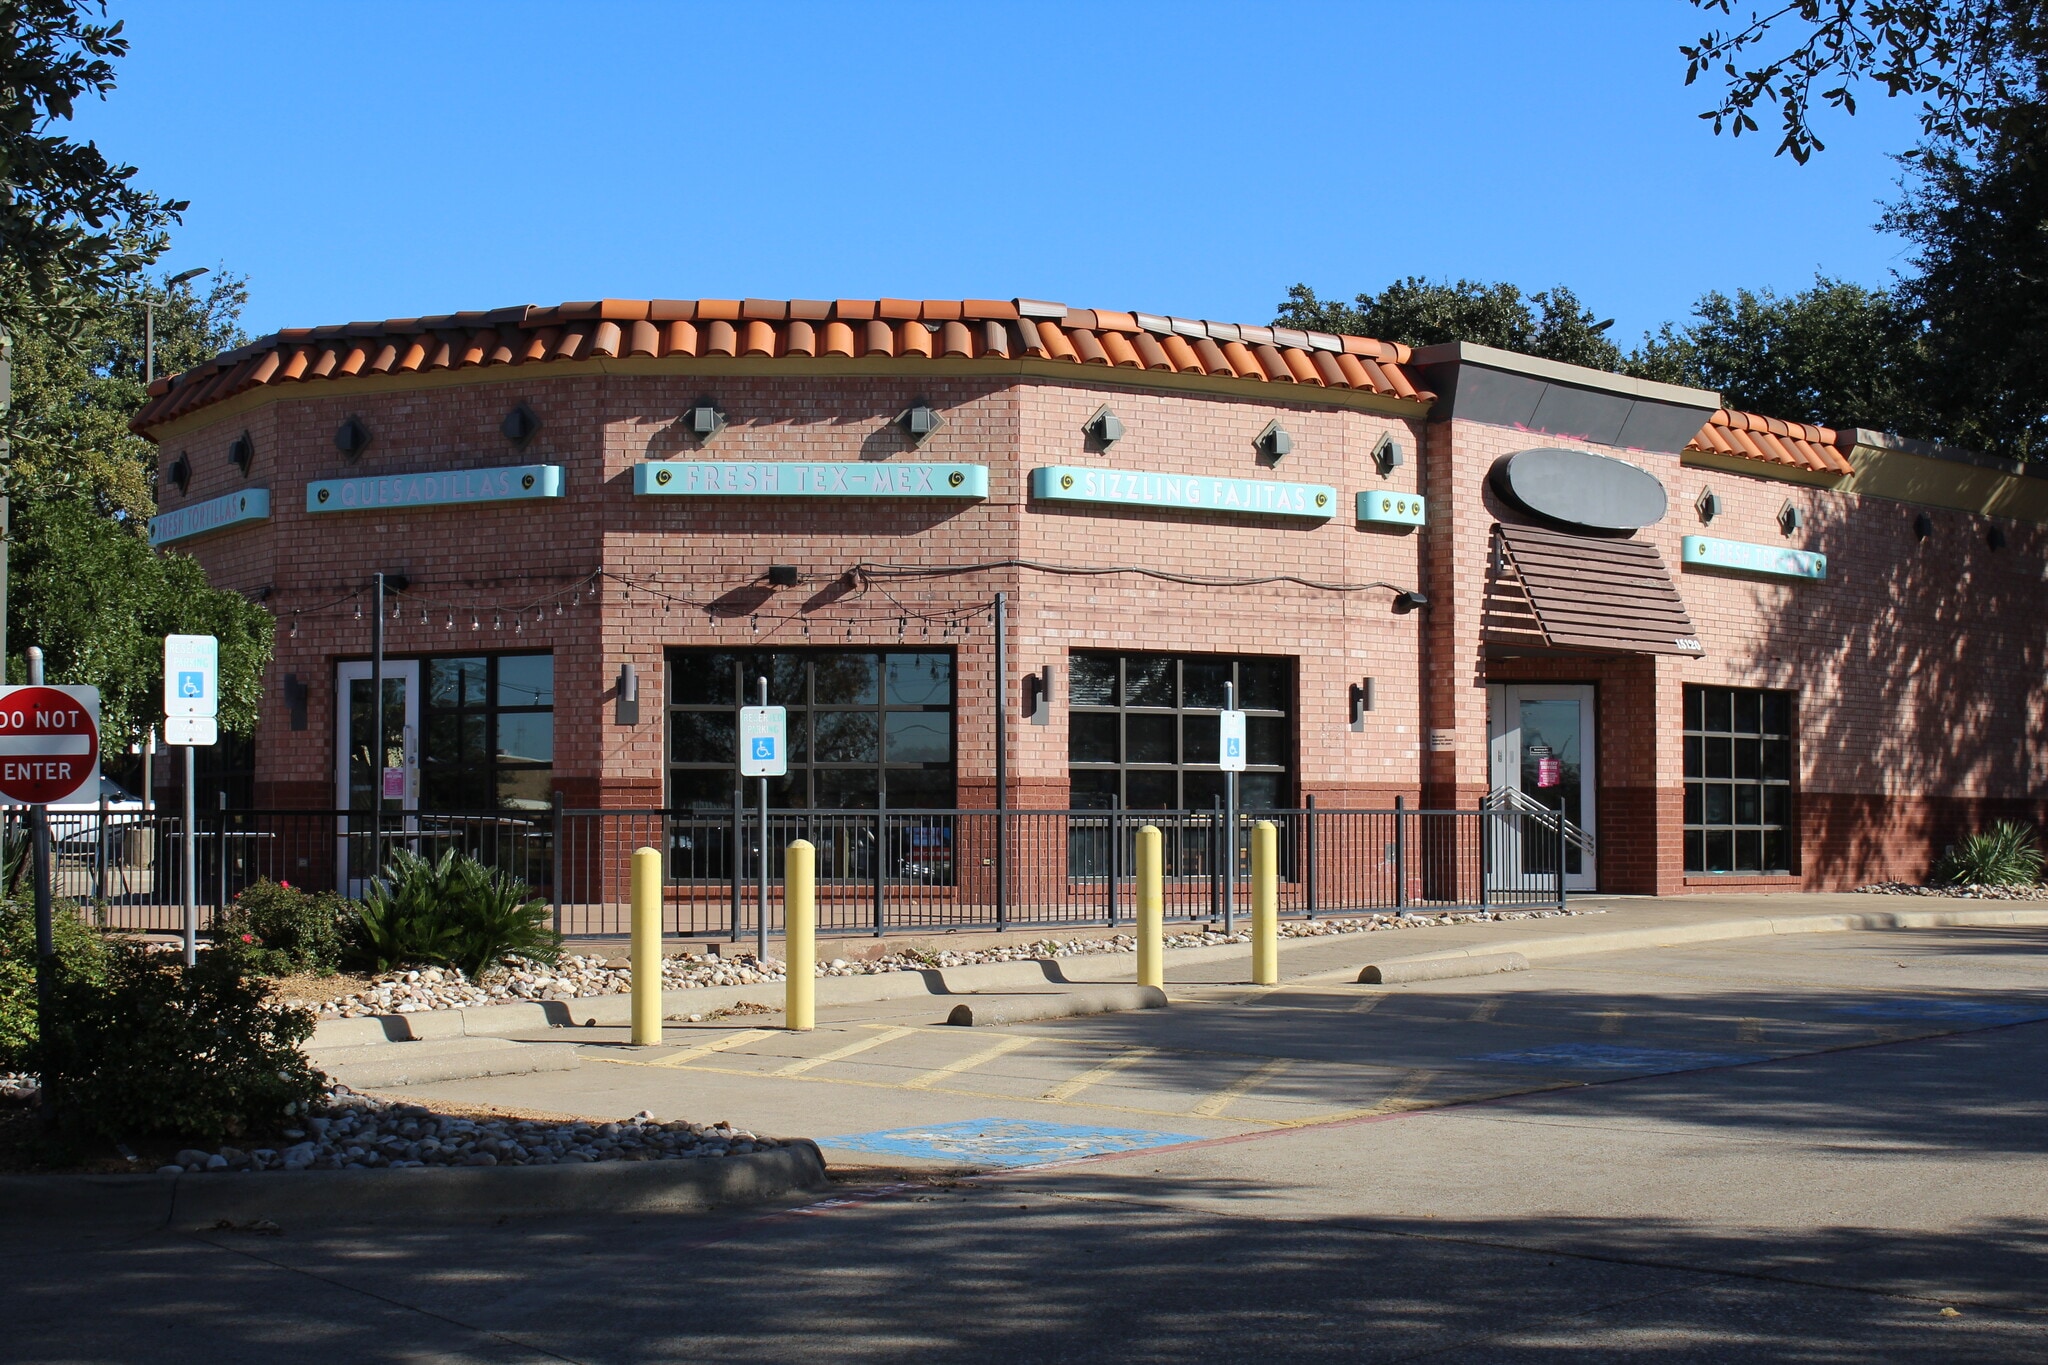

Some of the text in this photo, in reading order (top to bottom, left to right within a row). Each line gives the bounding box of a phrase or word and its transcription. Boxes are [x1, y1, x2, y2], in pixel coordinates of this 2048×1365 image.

[687, 466, 933, 492] FRESH TEX-MEX
[341, 471, 511, 506] QUESADILLAS
[1085, 471, 1306, 511] SIZZLING FAJITAS
[158, 495, 237, 540] FRESH TORTILLAS
[1711, 541, 1751, 566] FRESH
[169, 643, 214, 654] RESERVED
[1674, 638, 1701, 650] 15120
[174, 657, 209, 668] PARKING
[36, 710, 79, 728] NOT
[743, 713, 782, 722] RESERVED
[748, 725, 779, 734] PARKING
[4, 762, 72, 781] ENTER
